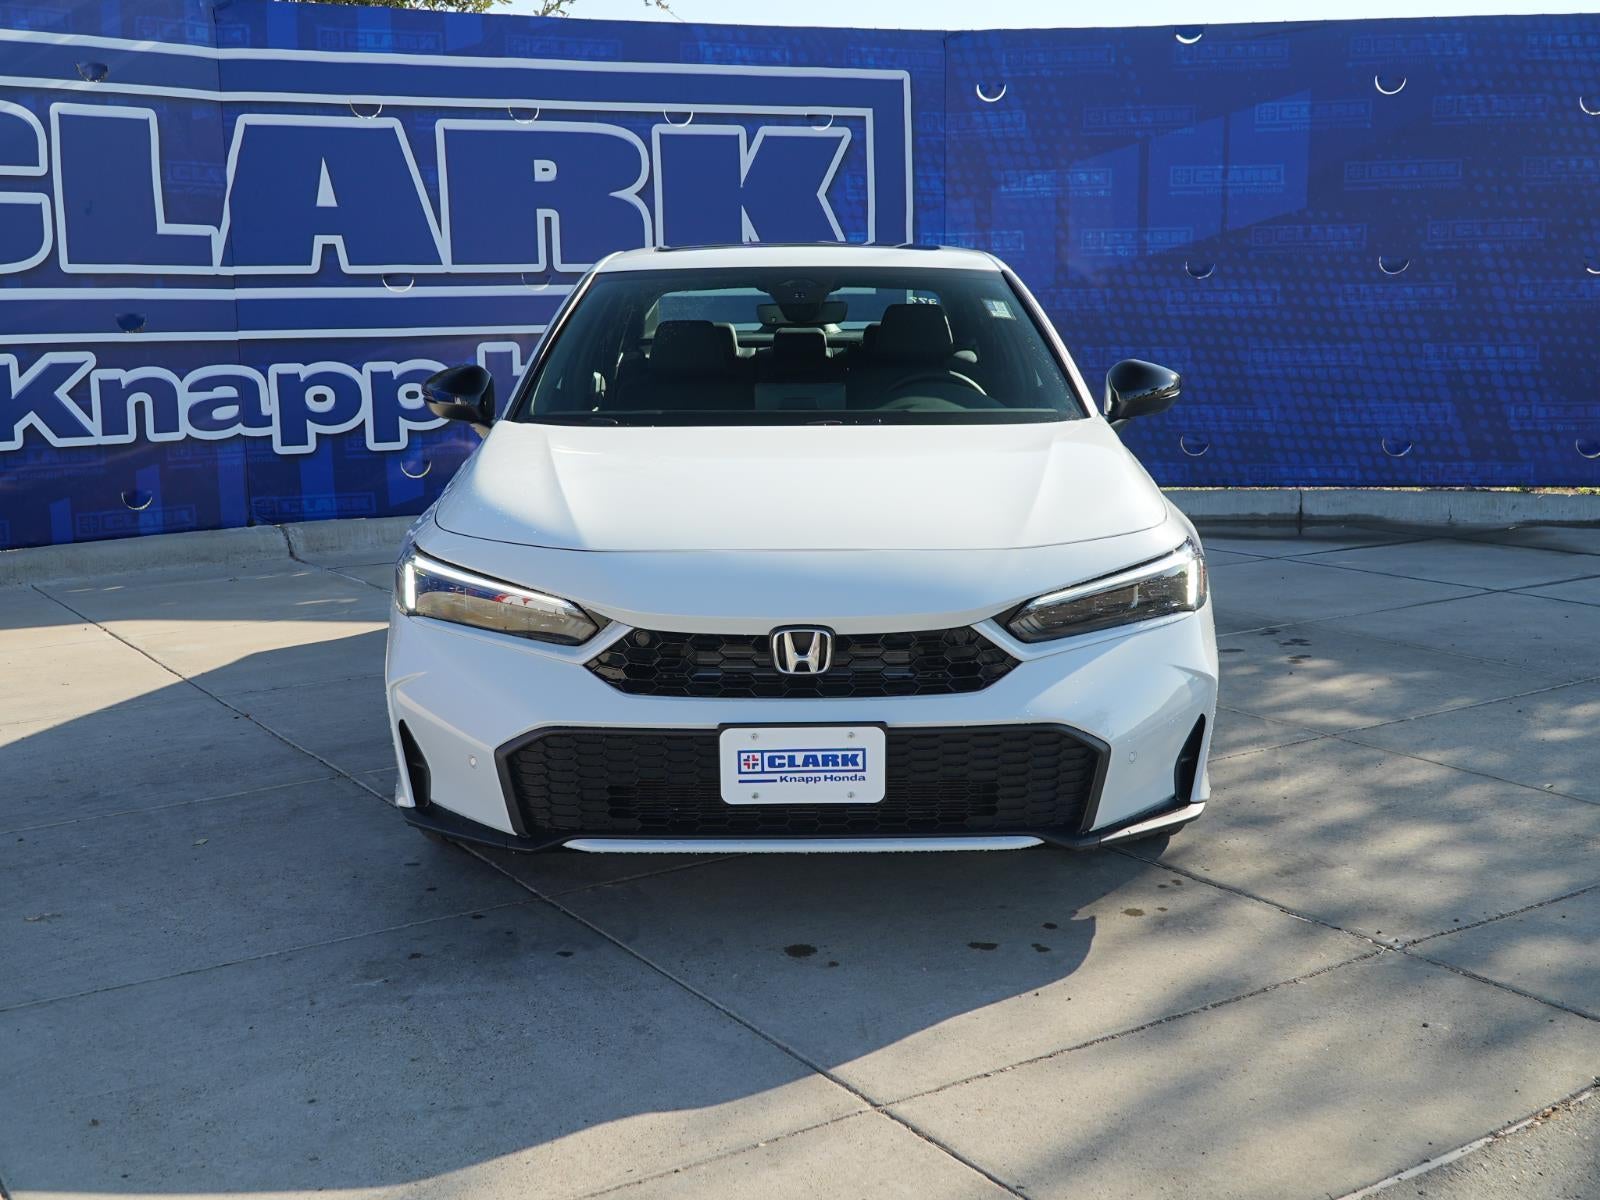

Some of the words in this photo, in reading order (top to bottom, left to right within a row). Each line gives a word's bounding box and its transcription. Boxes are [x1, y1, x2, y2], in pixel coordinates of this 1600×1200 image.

[0, 351, 449, 454] Knapp
[767, 753, 860, 769] CLARK
[779, 775, 822, 785] Knapp
[823, 774, 866, 783] Honda
